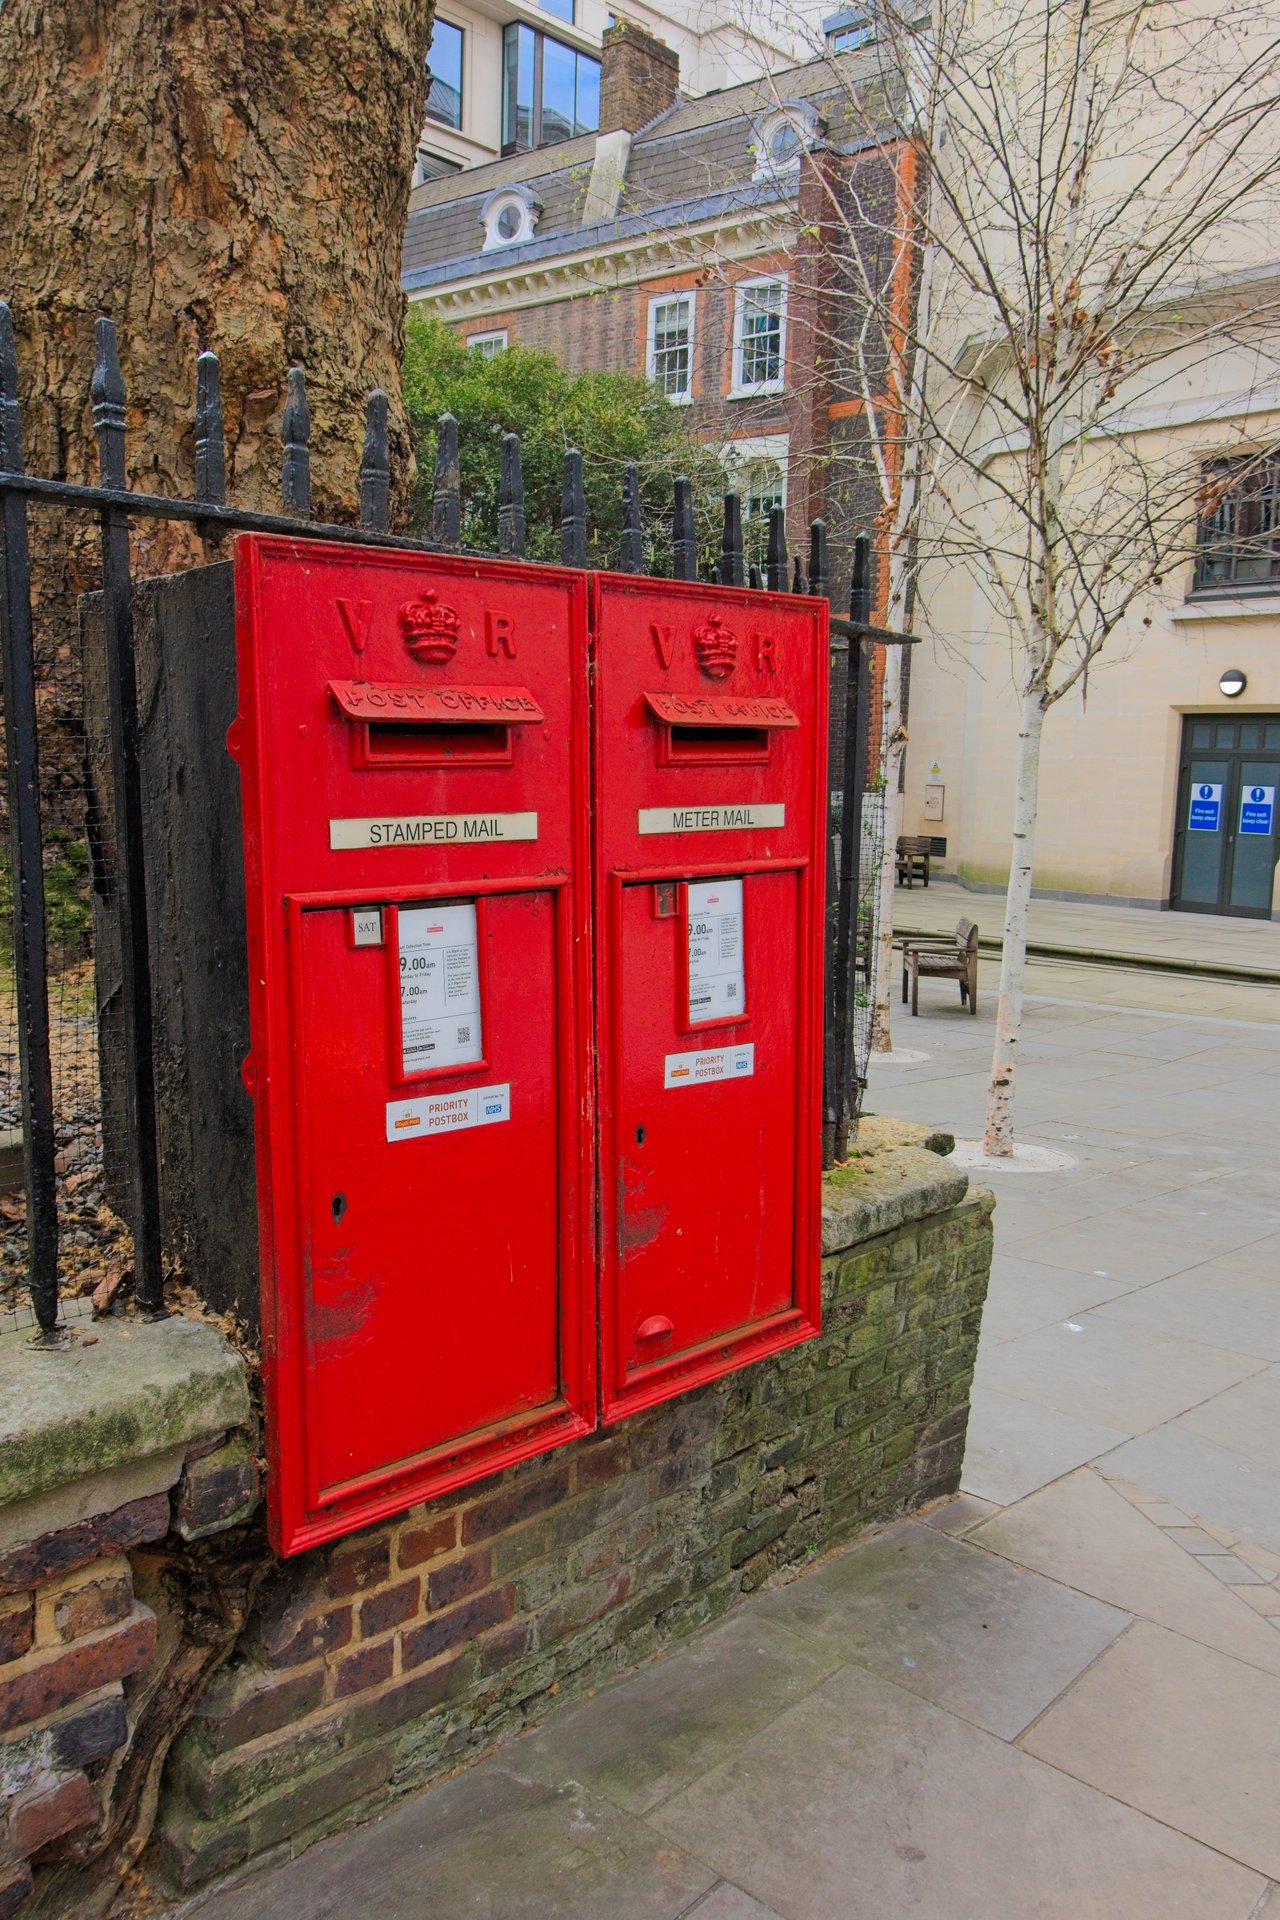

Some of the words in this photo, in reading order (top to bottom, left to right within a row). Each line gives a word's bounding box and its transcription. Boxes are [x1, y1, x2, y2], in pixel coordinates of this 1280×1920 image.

[336, 598, 373, 653] V
[485, 609, 517, 659] R
[651, 623, 676, 669] V
[755, 632, 776, 673] R
[345, 689, 425, 709] POST
[440, 693, 536, 712] OFFICE
[657, 699, 716, 718] POST
[673, 811, 720, 829] METER
[723, 809, 754, 826] MAIL
[370, 821, 458, 843] STAMPED
[463, 819, 504, 838] MAIL
[358, 921, 377, 933] SAT
[695, 1055, 725, 1066] PRIORITY
[695, 1066, 724, 1077] POSTBOX
[428, 1098, 469, 1114] PRIORITY
[486, 1105, 501, 1114] NHS
[428, 1112, 469, 1127] POSTBOX
